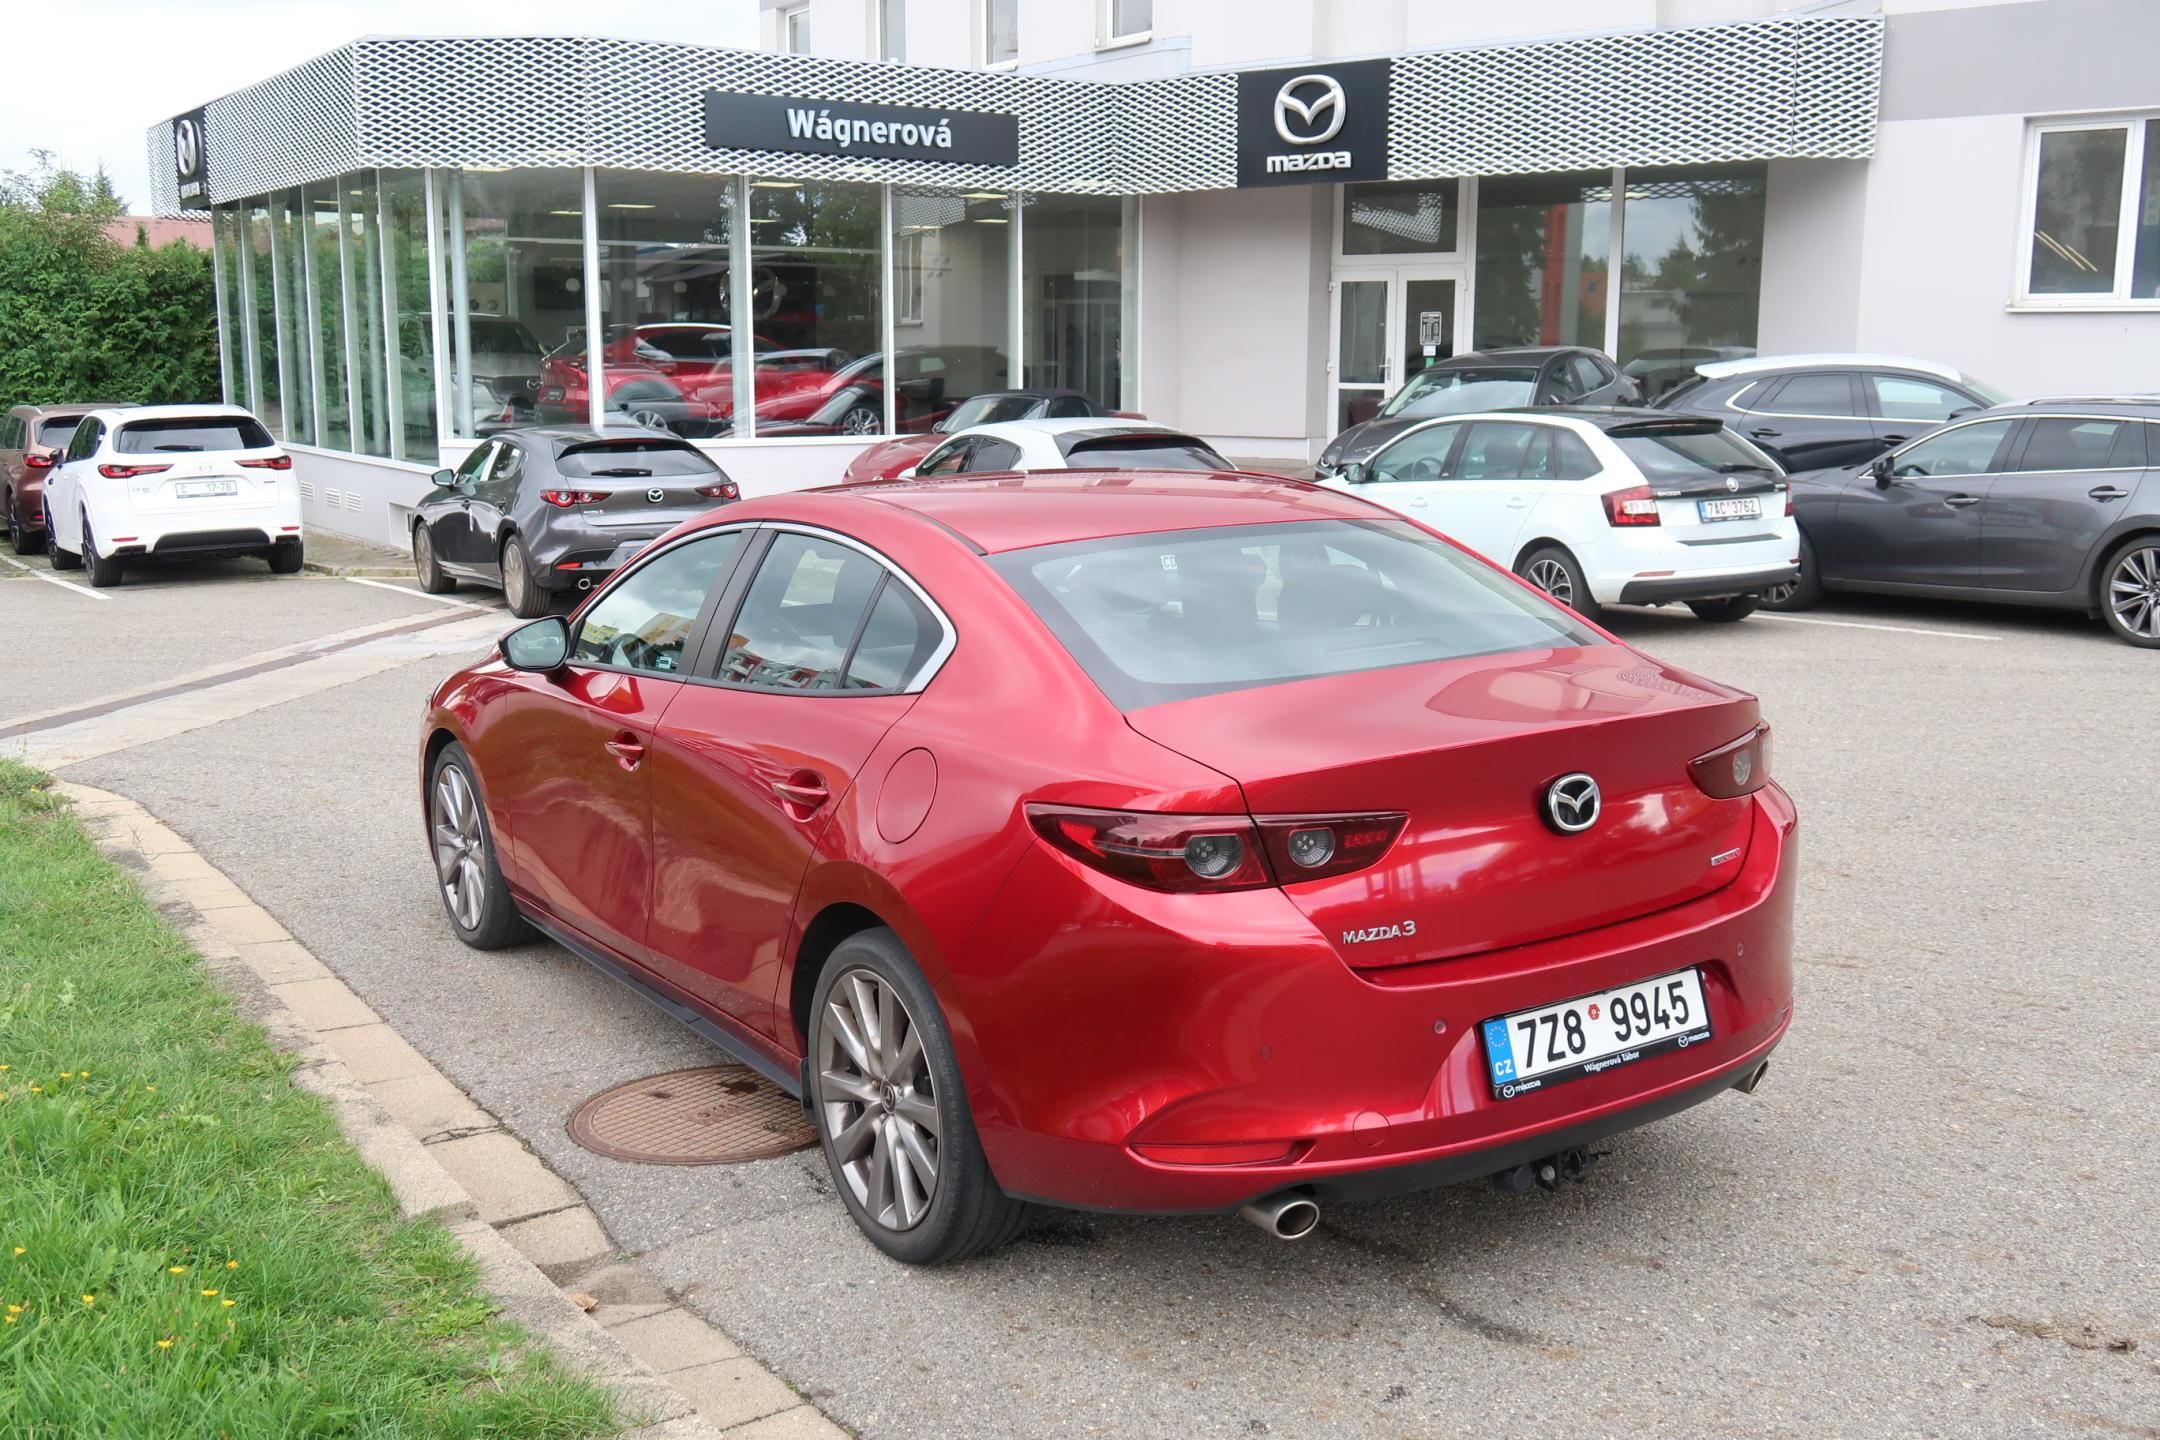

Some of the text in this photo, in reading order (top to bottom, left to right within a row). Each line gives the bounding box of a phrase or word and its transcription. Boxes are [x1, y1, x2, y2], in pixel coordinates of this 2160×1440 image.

[786, 107, 952, 148] Wágnerová
[1266, 151, 1352, 173] mazda
[1731, 499, 1756, 514] 3762
[1517, 980, 1690, 1069] 7Z8 9945
[1495, 1059, 1513, 1076] CZ
[1584, 1051, 1640, 1072] Wágnerová Tábor
